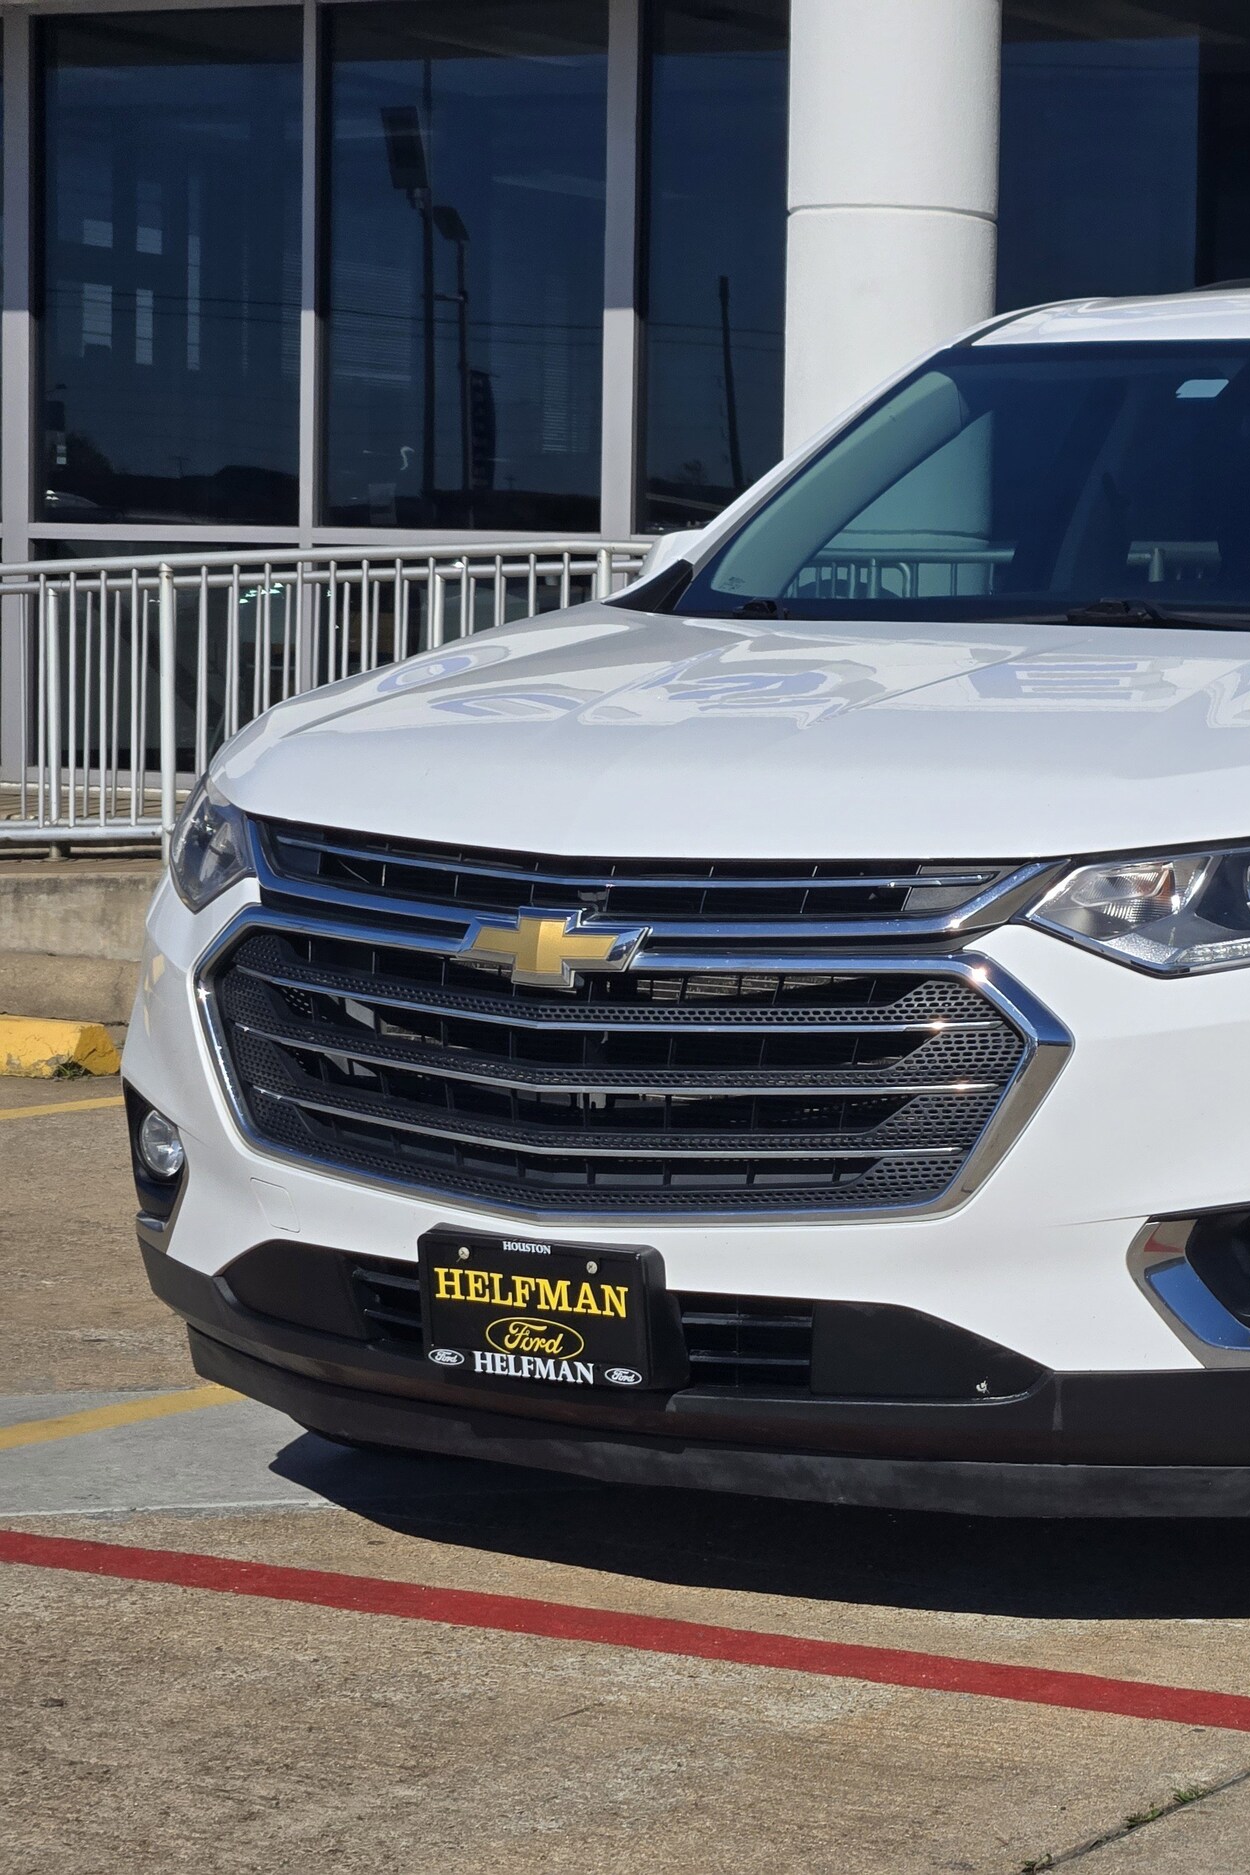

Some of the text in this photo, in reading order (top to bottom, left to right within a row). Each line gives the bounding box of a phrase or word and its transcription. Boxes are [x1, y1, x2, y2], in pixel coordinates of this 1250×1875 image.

[503, 1241, 551, 1255] HOUSTON
[434, 1267, 628, 1319] HELFMAN
[504, 1321, 564, 1354] Ford
[434, 1351, 458, 1364] Ford
[473, 1351, 595, 1385] HELFMAN
[611, 1369, 635, 1383] Ford
